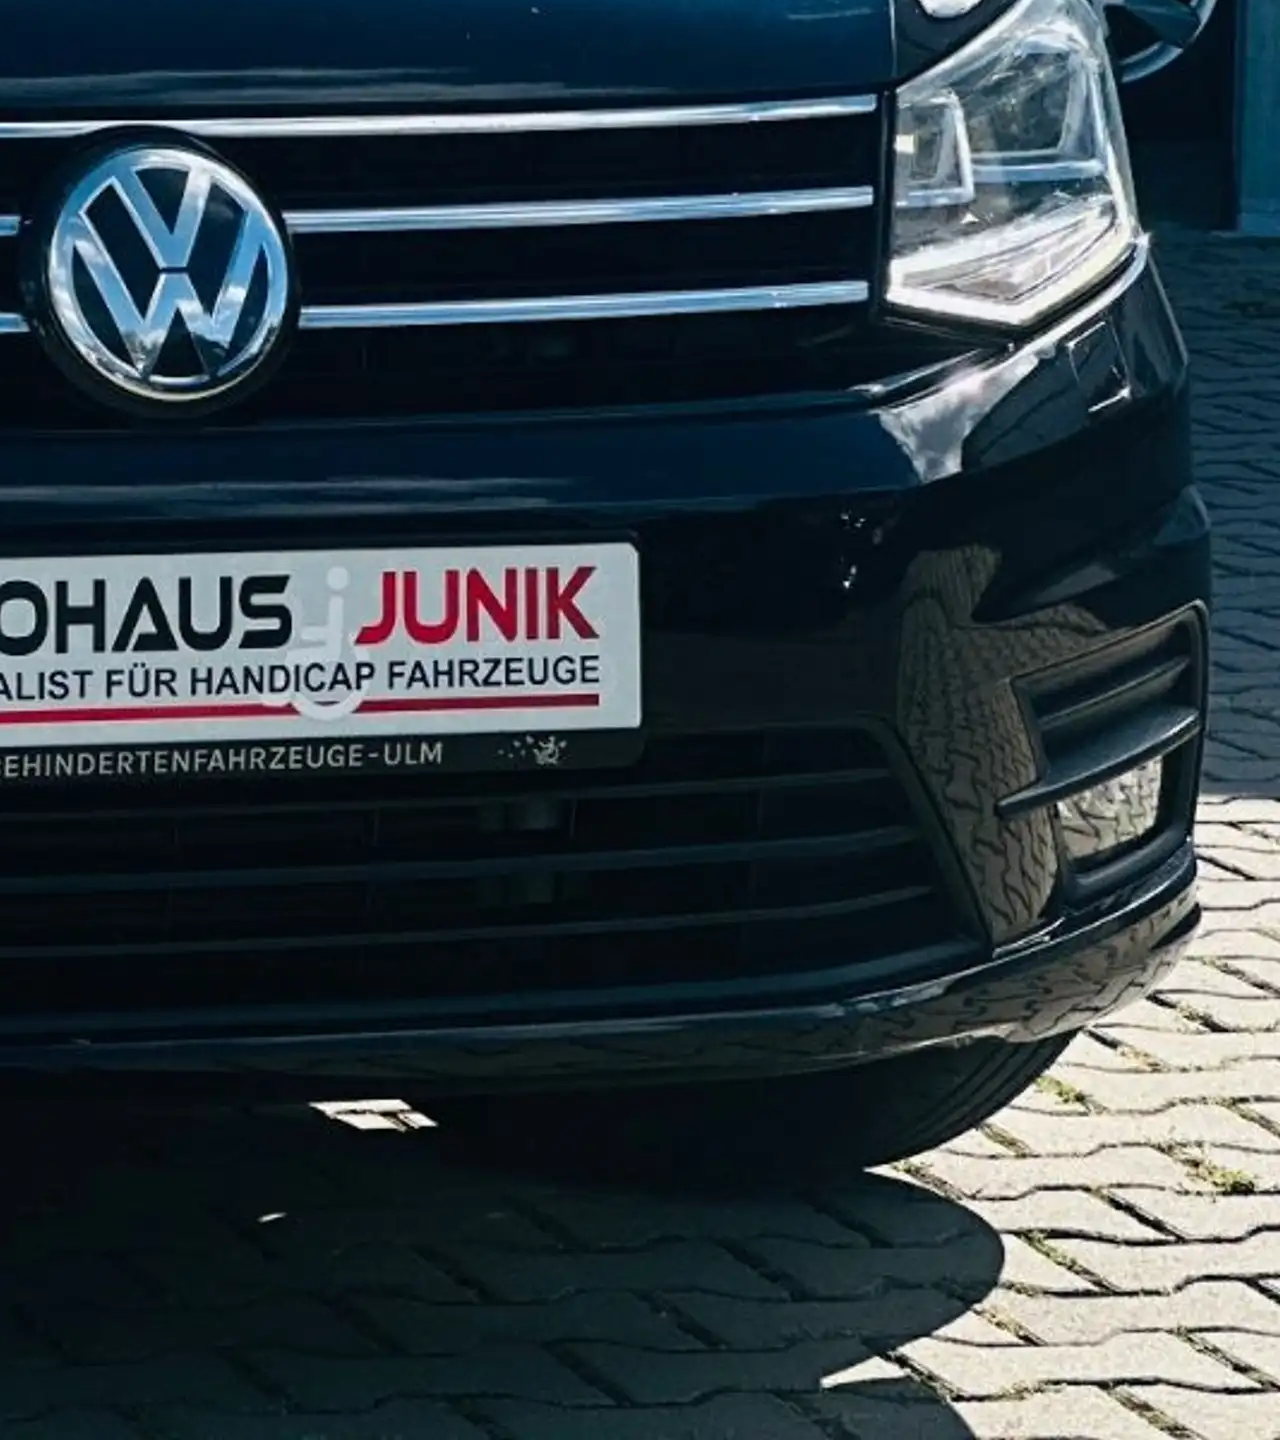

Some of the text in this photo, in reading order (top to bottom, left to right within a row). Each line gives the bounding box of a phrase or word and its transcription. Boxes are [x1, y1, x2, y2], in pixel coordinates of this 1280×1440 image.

[62, 158, 278, 390] VW
[354, 565, 600, 647] JUNIK
[106, 662, 178, 699] FÜR
[190, 661, 375, 696] HANDICAP
[387, 655, 600, 690] FAHRZEUGE
